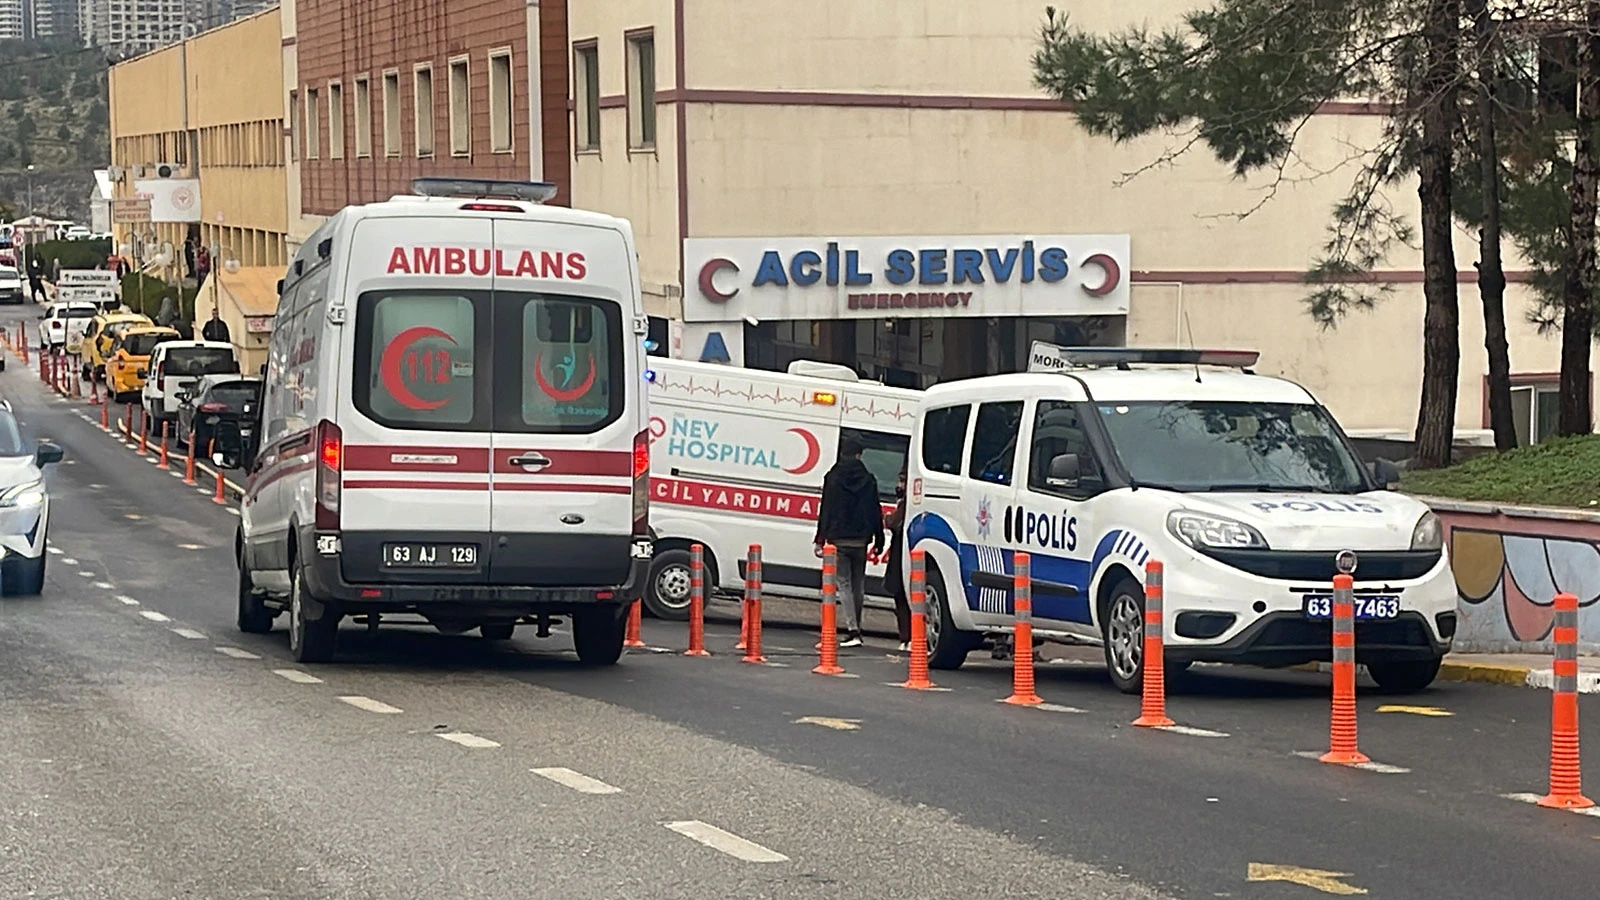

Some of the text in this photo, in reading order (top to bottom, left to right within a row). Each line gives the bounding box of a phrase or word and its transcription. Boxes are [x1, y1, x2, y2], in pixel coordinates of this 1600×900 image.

[387, 247, 586, 280] AMBULANS
[752, 239, 1069, 287] ACİL SERVİS
[847, 292, 973, 310] EMERGENCY
[406, 350, 452, 385] 112
[1033, 353, 1065, 369] MOR
[671, 417, 719, 439] NEV
[668, 437, 781, 469] HOSPITAL
[649, 481, 694, 502] CİL
[702, 488, 791, 513] YARDIM
[1026, 508, 1078, 551] POLİS
[393, 546, 474, 563] 63 AJ 129
[1307, 598, 1398, 618] 63 7463
